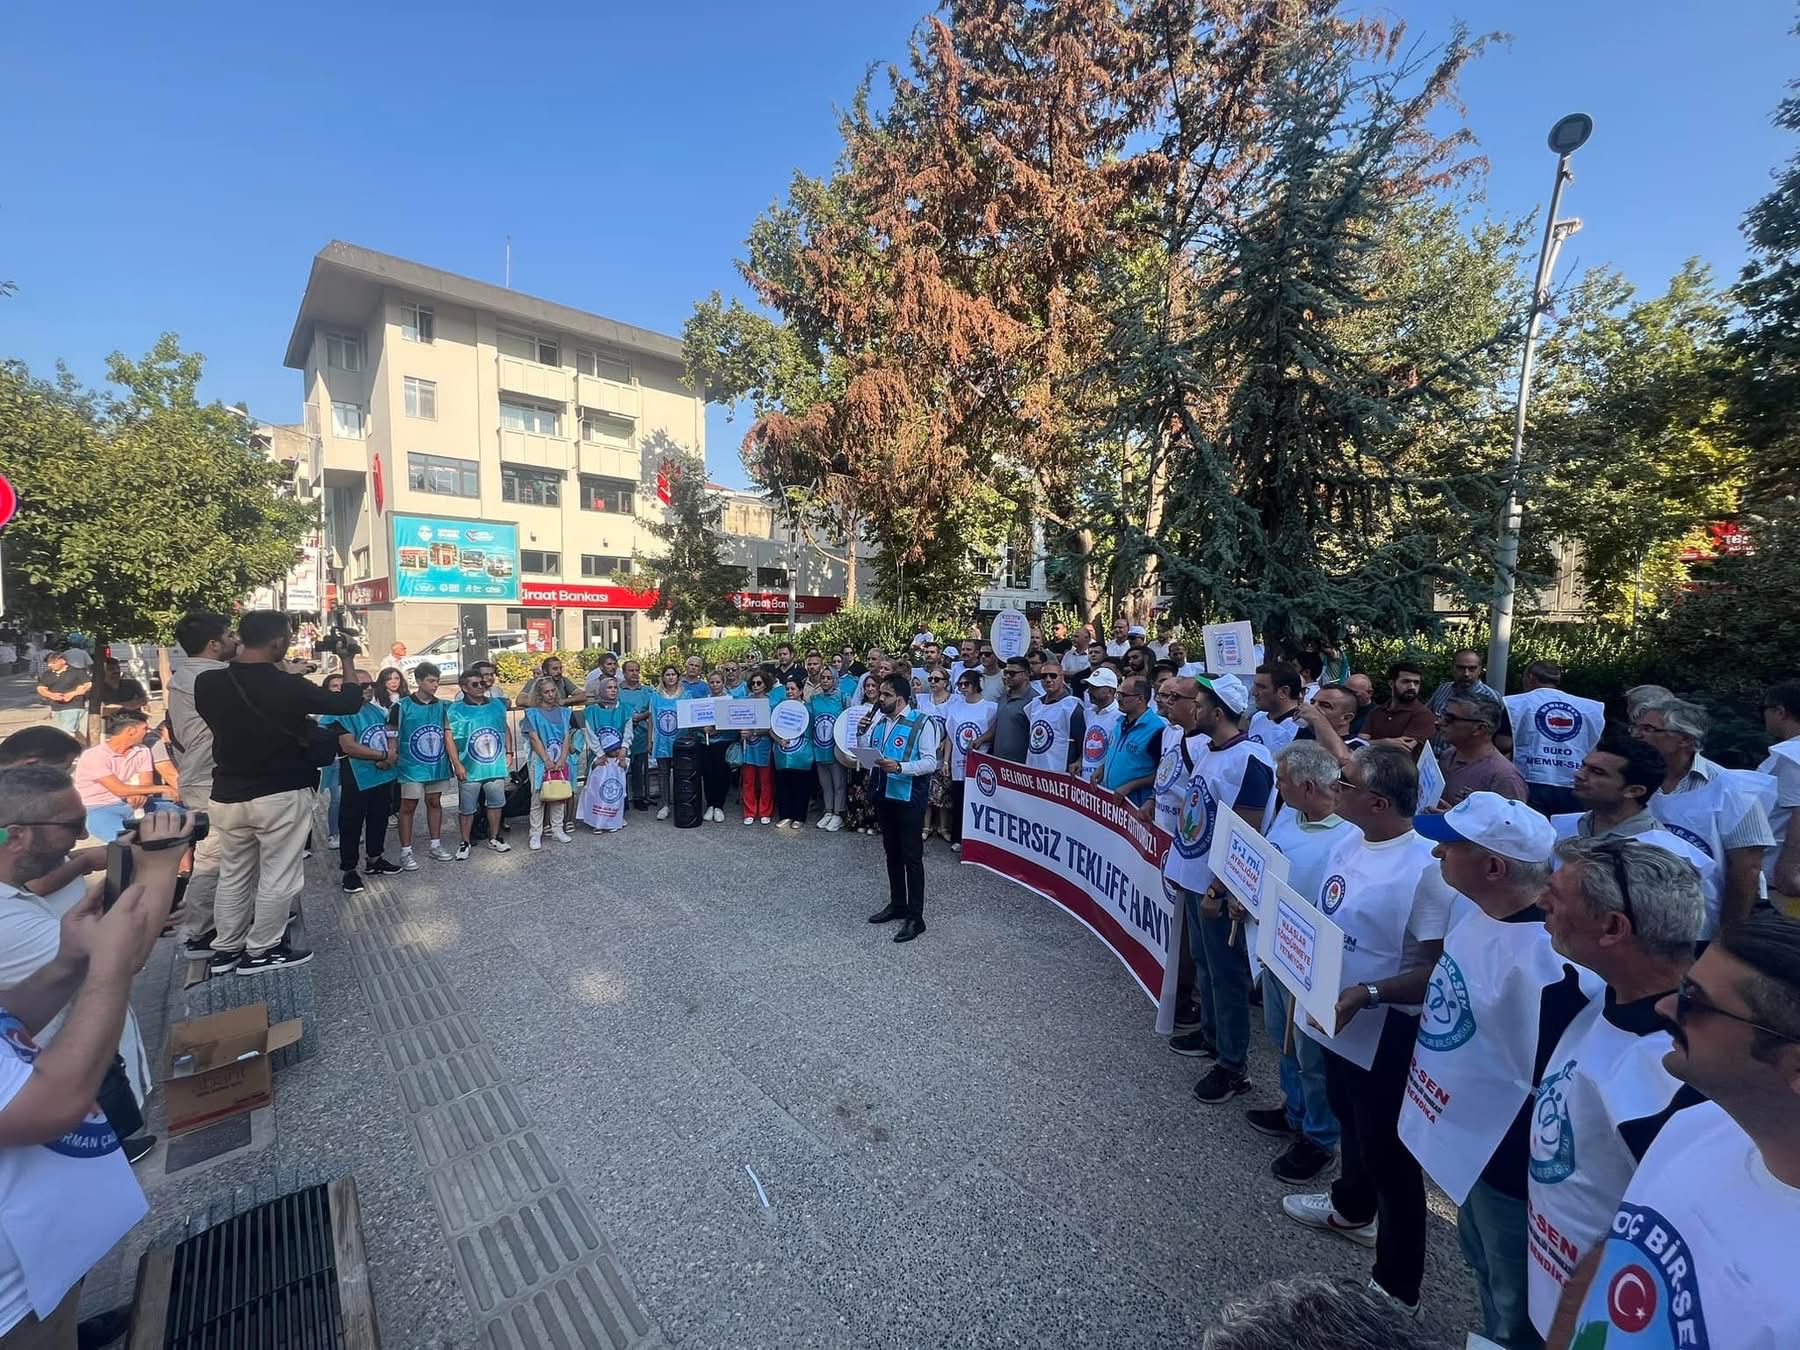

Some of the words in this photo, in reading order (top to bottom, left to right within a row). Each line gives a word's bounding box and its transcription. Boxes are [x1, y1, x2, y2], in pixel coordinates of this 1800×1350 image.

[559, 590, 609, 602] Bankası
[1543, 747, 1573, 756] BÜRO
[1000, 767, 1035, 790] GELİRDE
[1036, 776, 1070, 800] ADALET
[1070, 785, 1101, 816] ÜCRETTE
[1101, 800, 1128, 830] DENGE
[1232, 839, 1246, 859] 3+1
[970, 802, 1061, 862] YETERSİZ
[1066, 836, 1130, 914] TEKLİFE
[1129, 883, 1173, 953] HAYI
[1438, 956, 1469, 1010] BİR-SEN
